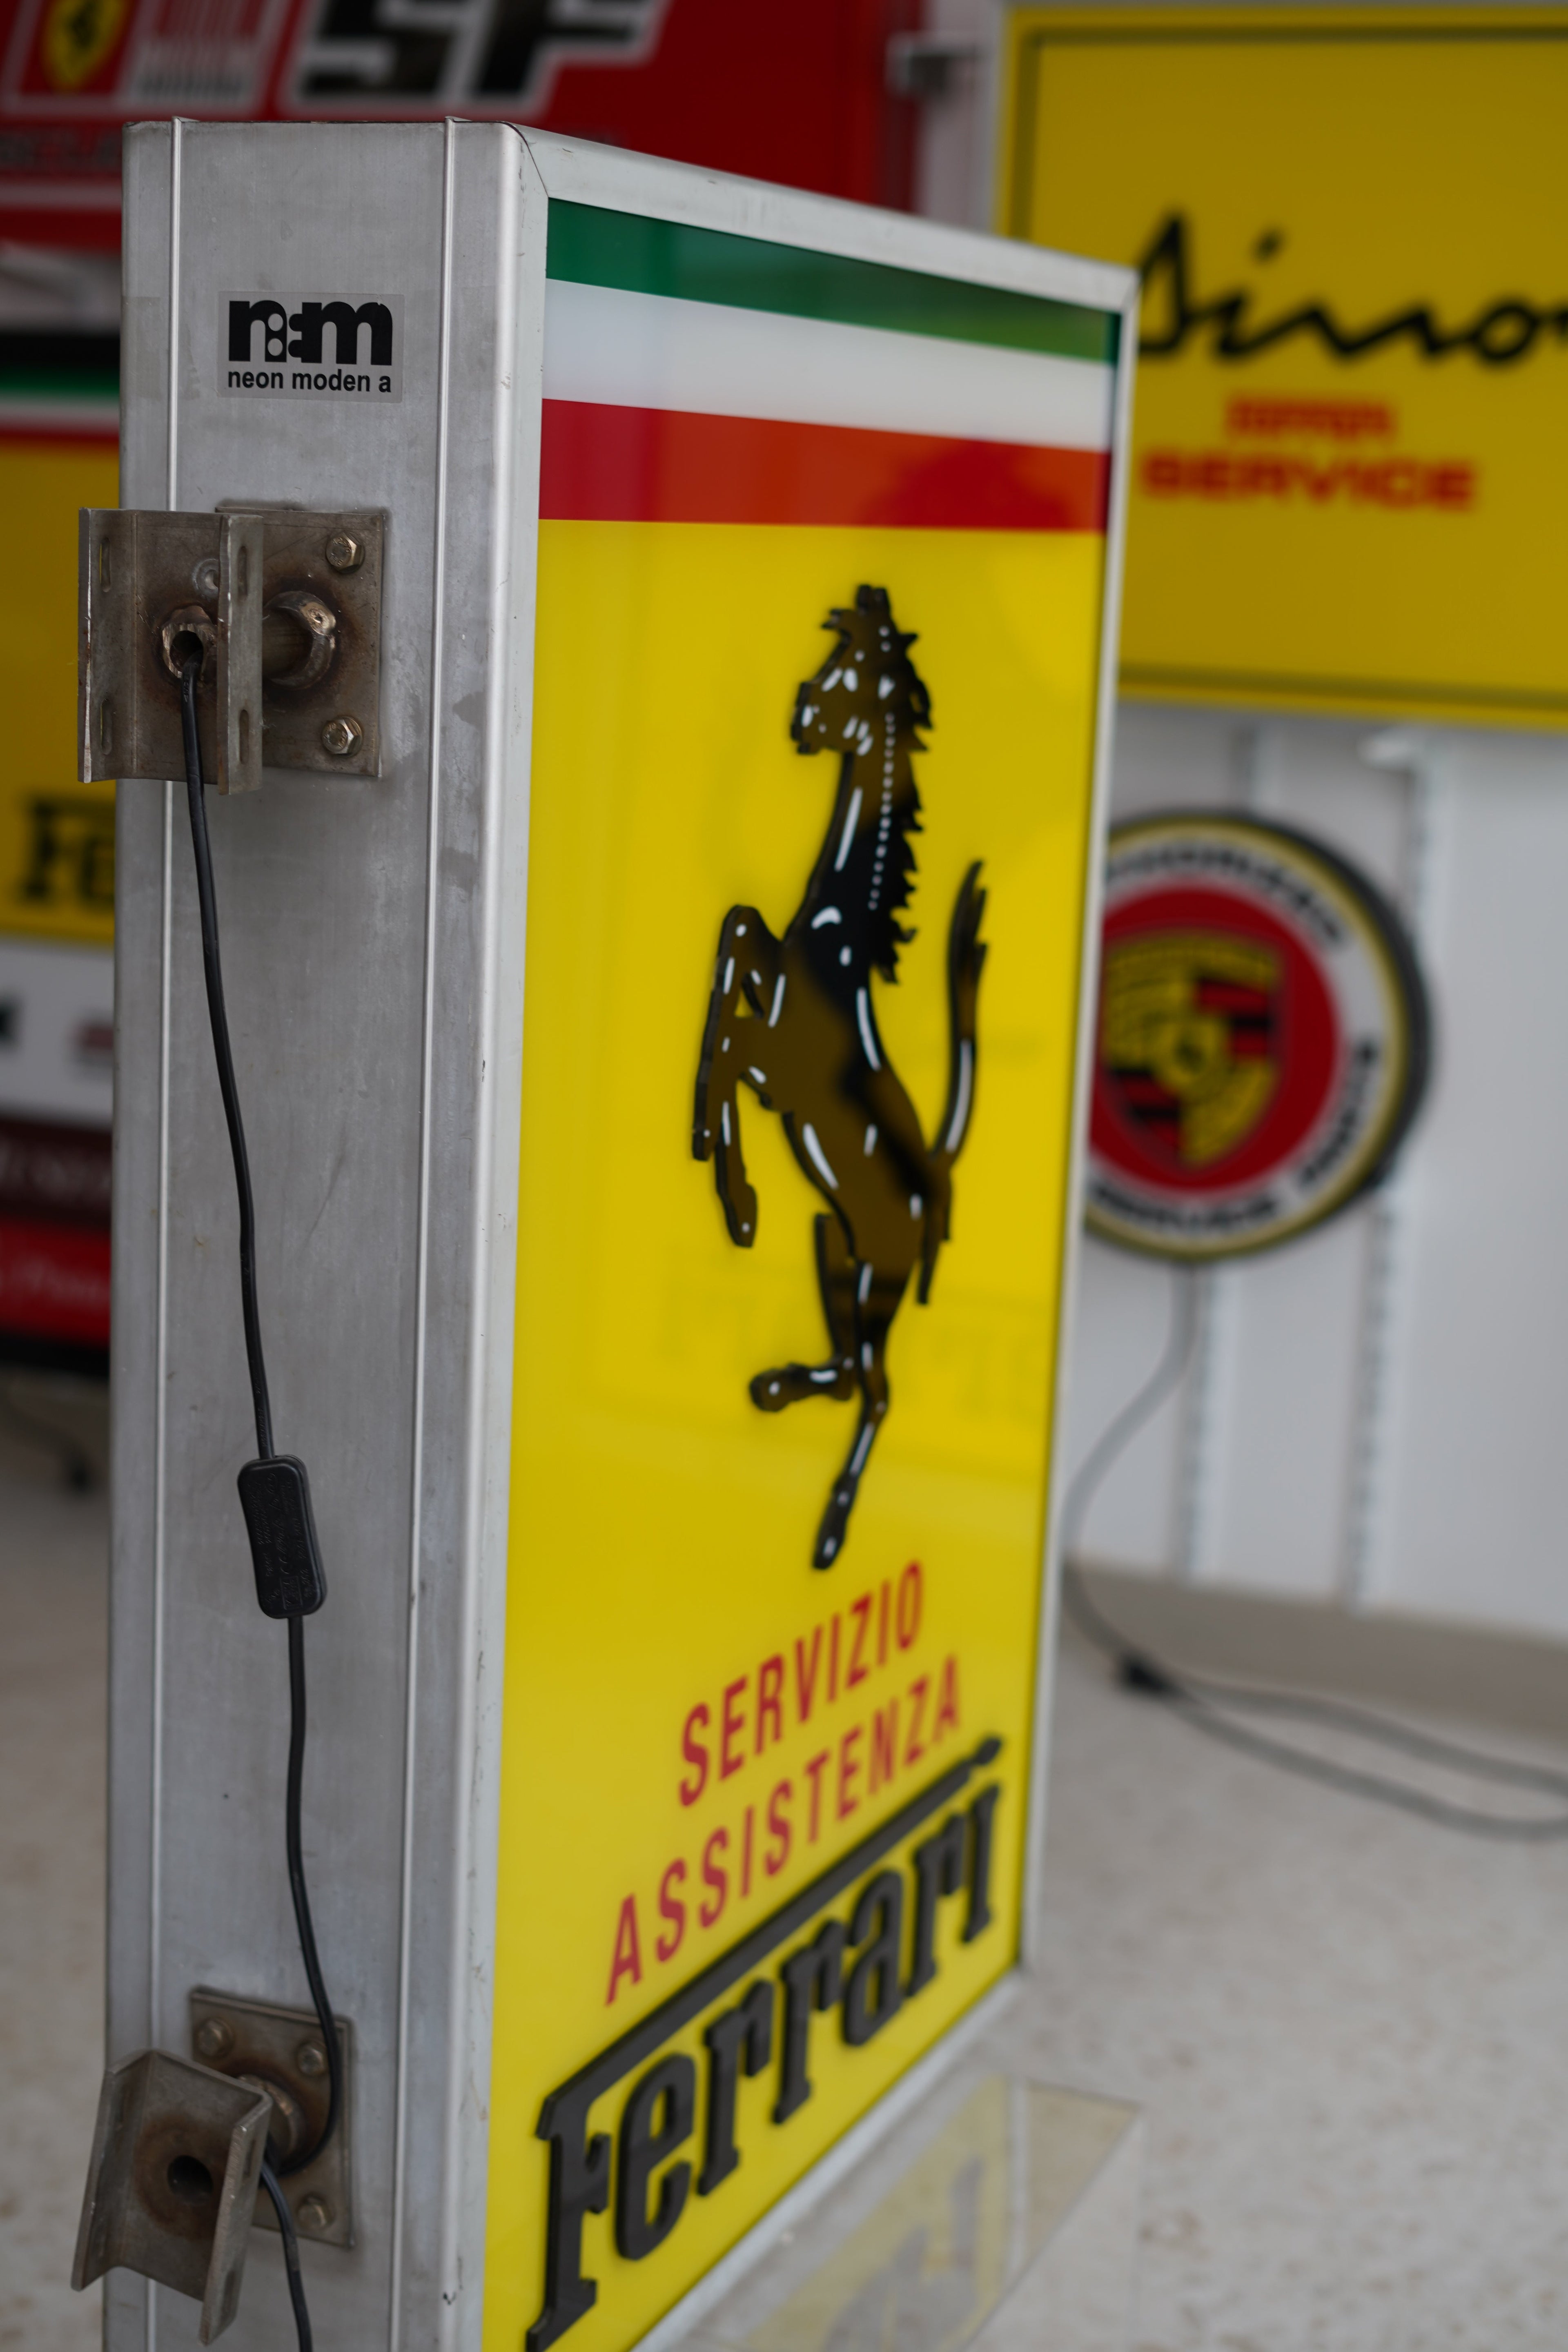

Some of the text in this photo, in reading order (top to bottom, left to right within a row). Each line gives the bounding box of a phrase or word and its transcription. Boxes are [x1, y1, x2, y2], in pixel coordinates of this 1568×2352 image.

[228, 371, 283, 389] neon
[1143, 452, 1474, 511] SERVICE
[679, 1560, 923, 1807] SERVIZIO
[606, 1655, 960, 2008] ASSISTENZA
[524, 1733, 1004, 2352] Ferrari
